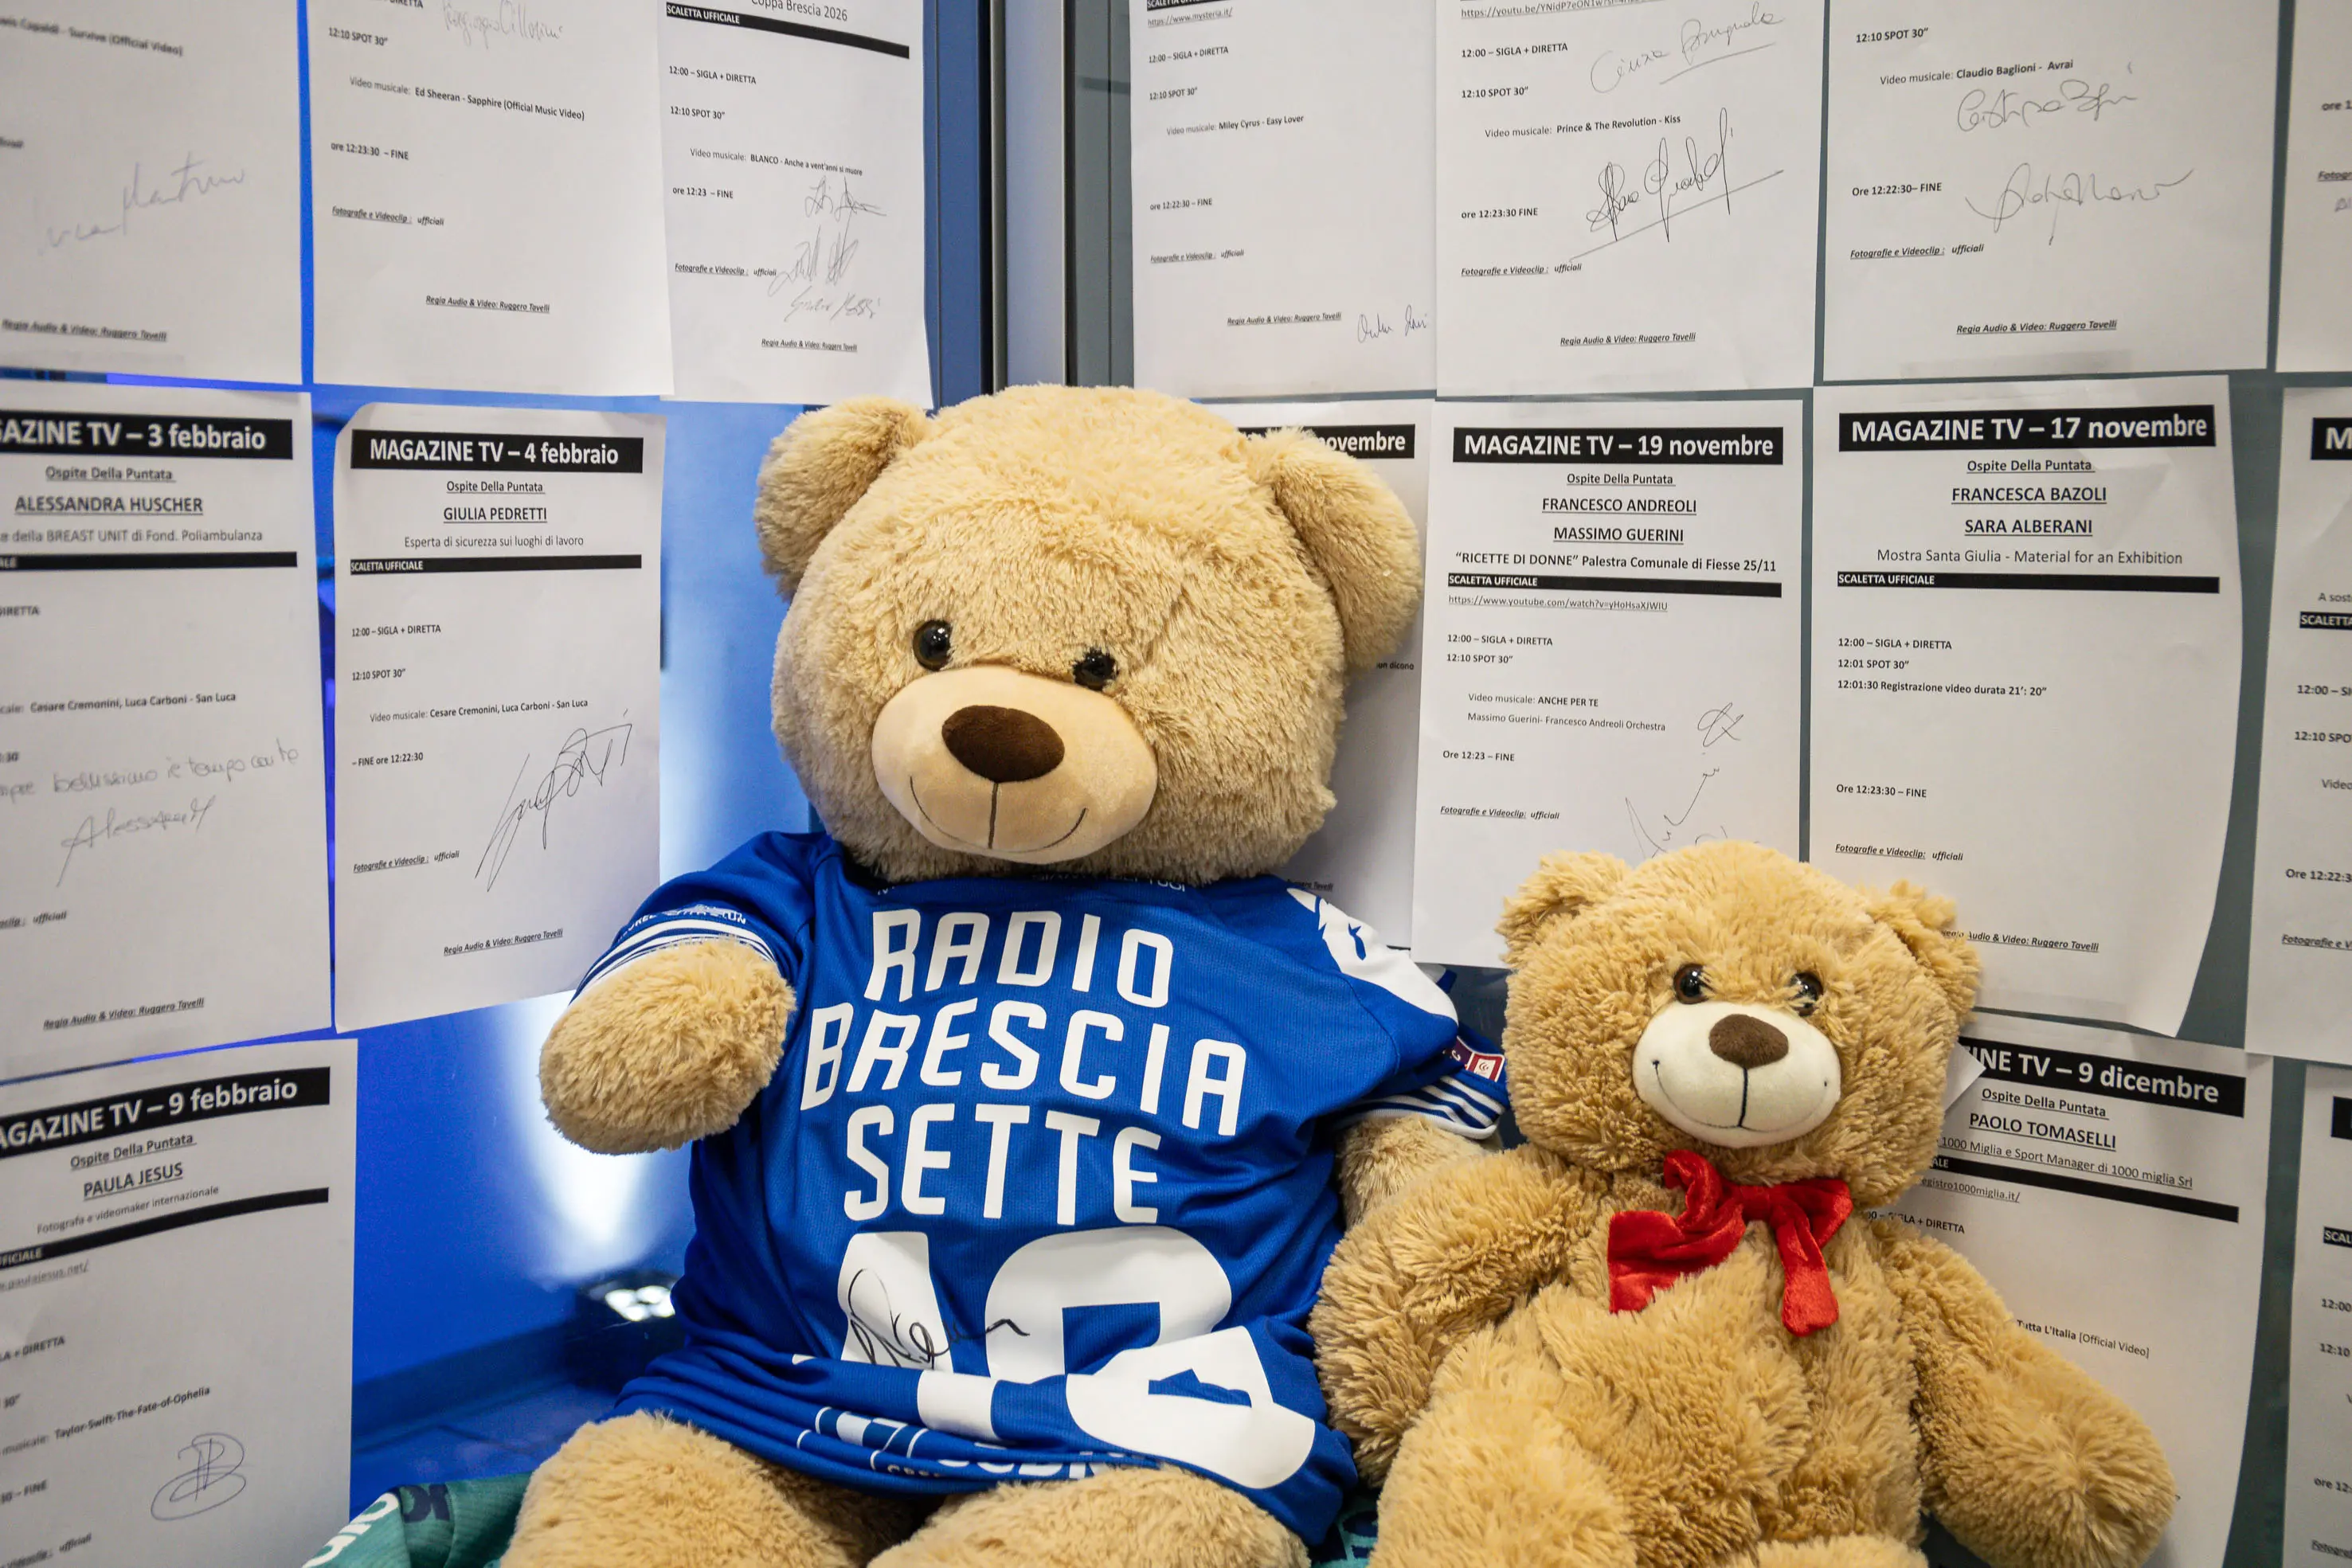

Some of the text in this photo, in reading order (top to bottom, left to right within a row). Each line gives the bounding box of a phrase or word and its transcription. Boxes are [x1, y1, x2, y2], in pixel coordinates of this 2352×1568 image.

[786, 0, 847, 22] Brescia 2026
[1880, 59, 2074, 85] Video musicale: Claudio Baglioni Avrai
[415, 87, 585, 121] Ed Sheeran Sapphire (Official Music Video)
[1556, 115, 1681, 134] Prince & The Revolution Kiss
[1852, 187, 1869, 196] Ore
[1920, 182, 1942, 193] FINE
[1479, 209, 1516, 218] 12:23:30
[1518, 208, 1538, 217] FINE
[86, 422, 267, 450] TV 3 febbraio
[1852, 413, 2207, 442] MAGAZINE TV 17 novembre
[370, 439, 619, 464] MAGAZINE TV 4 febbraio
[1465, 433, 1774, 456] MAGAZINE TV 19 novembre
[1967, 459, 2092, 473] Ospite Della Puntata
[446, 480, 543, 495] Ospite Della Puntata
[1567, 473, 1673, 486] Ospite Della Puntata
[1952, 487, 2107, 502] FRANCESCA BAZOLI
[15, 497, 202, 512] ALESSANDRA HUSCHER
[443, 506, 547, 521] GIULIA PEDRETTI
[1542, 498, 1696, 513] FRANCESCO ANDREOLI
[1554, 527, 1684, 542] MASSIMO GUERINI
[1965, 519, 2092, 534] SARA ALBERANI
[404, 534, 584, 549] Esperta di sicurezza sui luoghi di lavoro
[1513, 553, 1525, 565] DI
[1582, 555, 1627, 567] Palestra
[1630, 557, 1689, 569] Comunale
[1692, 558, 1702, 569] di
[1706, 557, 1740, 570] Fiesse
[1743, 558, 1775, 573] 25/11
[1877, 549, 2182, 565] Mostra Santa Giulia Material for an Exhibition
[1449, 575, 1538, 586] SCALETTA UFFICIALE
[1837, 573, 1935, 585] SCALETTA UFFICIALE
[1838, 637, 1952, 650] 12:00 SIGLA DIRETTA
[1838, 659, 1864, 668] 12:01
[1866, 659, 1892, 669] SPOT
[1837, 679, 1879, 690] 12:01:30
[1880, 681, 1943, 692] Registrazione
[1945, 683, 1972, 694] video
[1974, 685, 2006, 695] durata
[429, 699, 589, 718] Cesare Cremonini, Luca Carboni San Luca
[1468, 693, 1599, 707] Video musicale: ANCHE PER TE
[1467, 713, 1506, 722] Massimo
[1545, 715, 1587, 726] Francesco
[1588, 718, 1624, 729] Andreoli
[1626, 721, 1665, 731] Orchestra
[864, 908, 1174, 1008] RADIO
[800, 997, 1247, 1136] BRESCIA
[2017, 1054, 2051, 1077] TV
[2078, 1062, 2094, 1083] 9
[2100, 1065, 2219, 1103] dicembre
[108, 1077, 298, 1126] TV 9 febbraio
[1982, 1088, 2106, 1120] Ospite Della Puntata
[1970, 1112, 2116, 1149] PAOLO TOMASELLI
[843, 1102, 1162, 1226] SETTE
[1942, 1136, 2193, 1191] 1000 Miglia e Sport Manager di 1000 miglia Srl
[83, 1162, 183, 1198] PAULA JESUS
